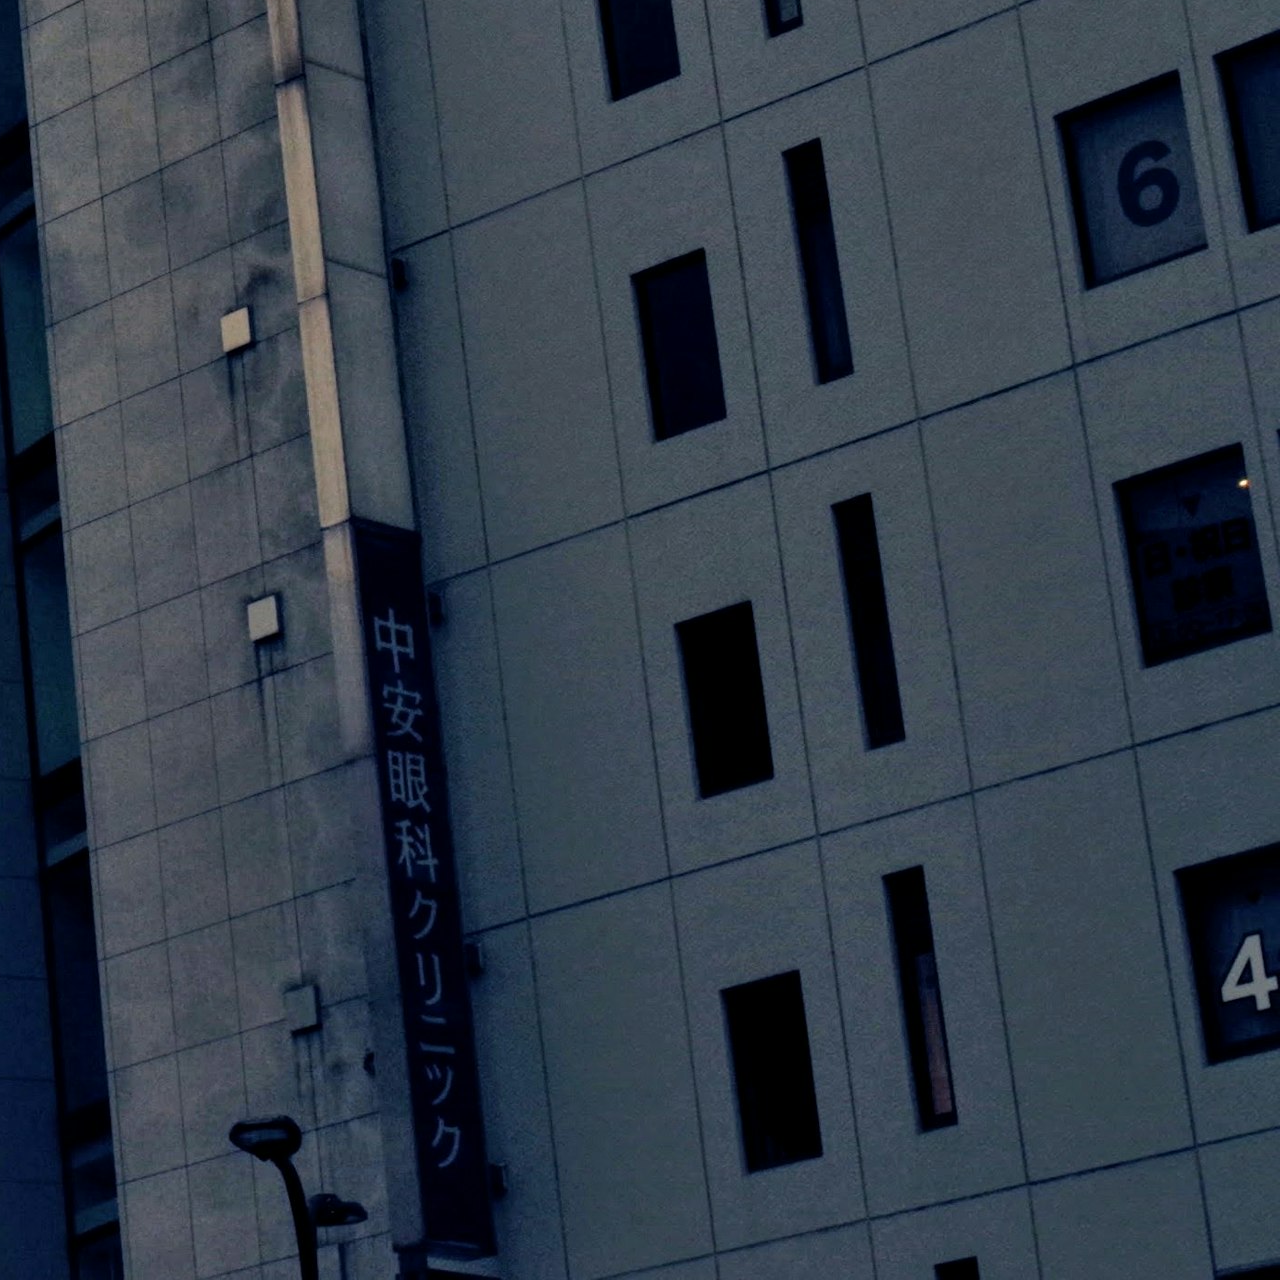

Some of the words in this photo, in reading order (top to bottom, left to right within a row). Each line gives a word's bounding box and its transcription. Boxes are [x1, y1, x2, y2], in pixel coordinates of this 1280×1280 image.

[1116, 139, 1182, 229] 6
[372, 608, 461, 1170] 中安眼科クリニック
